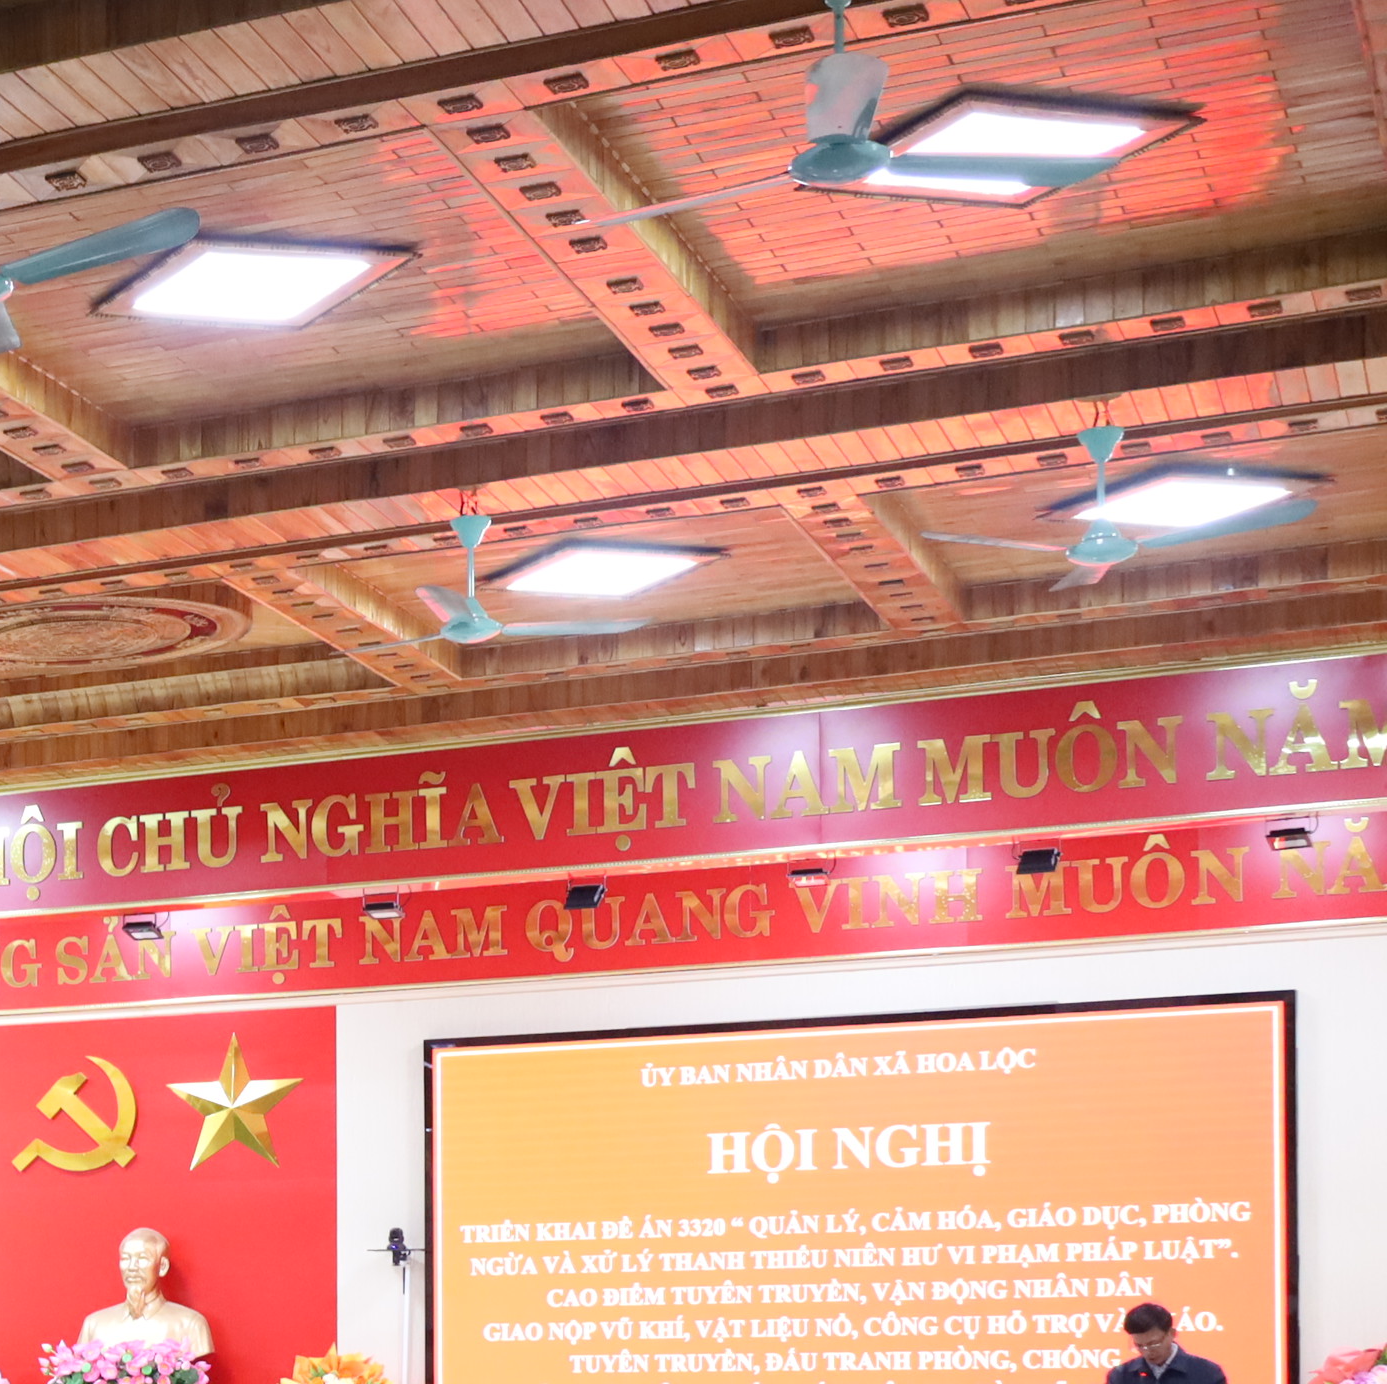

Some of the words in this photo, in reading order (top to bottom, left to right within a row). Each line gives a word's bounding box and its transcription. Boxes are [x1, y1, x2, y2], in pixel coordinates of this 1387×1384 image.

[96, 782, 244, 877] CHỦ
[260, 770, 506, 865] NGHĨA
[509, 746, 697, 851] VIỆT
[712, 741, 902, 824] NAM
[917, 700, 1184, 806] MUÔN
[55, 914, 176, 986] SẢN
[190, 904, 344, 984] VIỆT
[358, 903, 509, 965] NAM
[524, 882, 776, 963] QUANG
[789, 866, 984, 935] VINH
[1005, 833, 1250, 919] MUÔN
[1270, 816, 1387, 900] NĂ
[640, 1062, 676, 1087] ỦY
[679, 1064, 731, 1085] BAN
[735, 1055, 808, 1082] NHÂN
[813, 1052, 868, 1078] DÂN
[873, 1050, 911, 1075] XÃ
[916, 1052, 975, 1074] HOA
[979, 1047, 1036, 1074] LỘC
[707, 1123, 818, 1184] HỘI
[831, 1121, 991, 1177] NGHỊ
[460, 1219, 530, 1243] TRIỂN
[535, 1221, 597, 1241] KHAI
[601, 1215, 634, 1239] ĐỀ
[639, 1214, 673, 1238] ÁN
[677, 1218, 726, 1237] 3320
[748, 1210, 820, 1239] QUẢN
[825, 1208, 867, 1235] LÝ,
[871, 1206, 932, 1232] CẢM
[937, 1204, 1002, 1232] HÓA,
[1007, 1202, 1077, 1228] GIÁO
[1082, 1205, 1147, 1230] DỤC,
[1152, 1197, 1251, 1223] PHÒNG
[470, 1252, 538, 1276] NGỪA
[542, 1250, 576, 1274] VÀ
[580, 1249, 617, 1273] XỬ
[621, 1248, 654, 1272] LÝ
[659, 1251, 745, 1273] THANH
[750, 1244, 828, 1270] THIẾU
[833, 1242, 895, 1268] NIÊN
[901, 1243, 943, 1266] HƯ
[947, 1245, 975, 1265] VI
[981, 1242, 1060, 1268] PHẠM
[1065, 1236, 1138, 1262] PHÁP
[546, 1288, 598, 1307] CAO
[602, 1282, 666, 1306] ĐIỂM
[670, 1279, 753, 1305] TUYÊN
[758, 1278, 867, 1305] TRUYỀN,
[871, 1279, 926, 1306] VẬN
[931, 1278, 1008, 1305] ĐỘNG
[1013, 1272, 1090, 1298] NHÂN
[1095, 1271, 1153, 1297] DÂN
[483, 1322, 543, 1342] GIAO
[548, 1319, 597, 1345] NỘP
[599, 1317, 633, 1340] VŨ
[638, 1315, 690, 1342] KHÍ,
[695, 1317, 746, 1343] VẬT
[750, 1316, 809, 1342] LIỆU
[815, 1312, 859, 1340] NỔ,
[863, 1311, 938, 1336] CÔNG
[944, 1315, 980, 1340] CỤ
[1032, 1312, 1090, 1338] TRỢ
[569, 1348, 649, 1373] TUYÊN
[654, 1348, 760, 1375] TRUYỀN,
[765, 1347, 818, 1372] ĐẤU
[822, 1351, 911, 1371] TRANH
[918, 1345, 1017, 1372] PHÒNG,
[1022, 1344, 1121, 1369] CHỐNG
